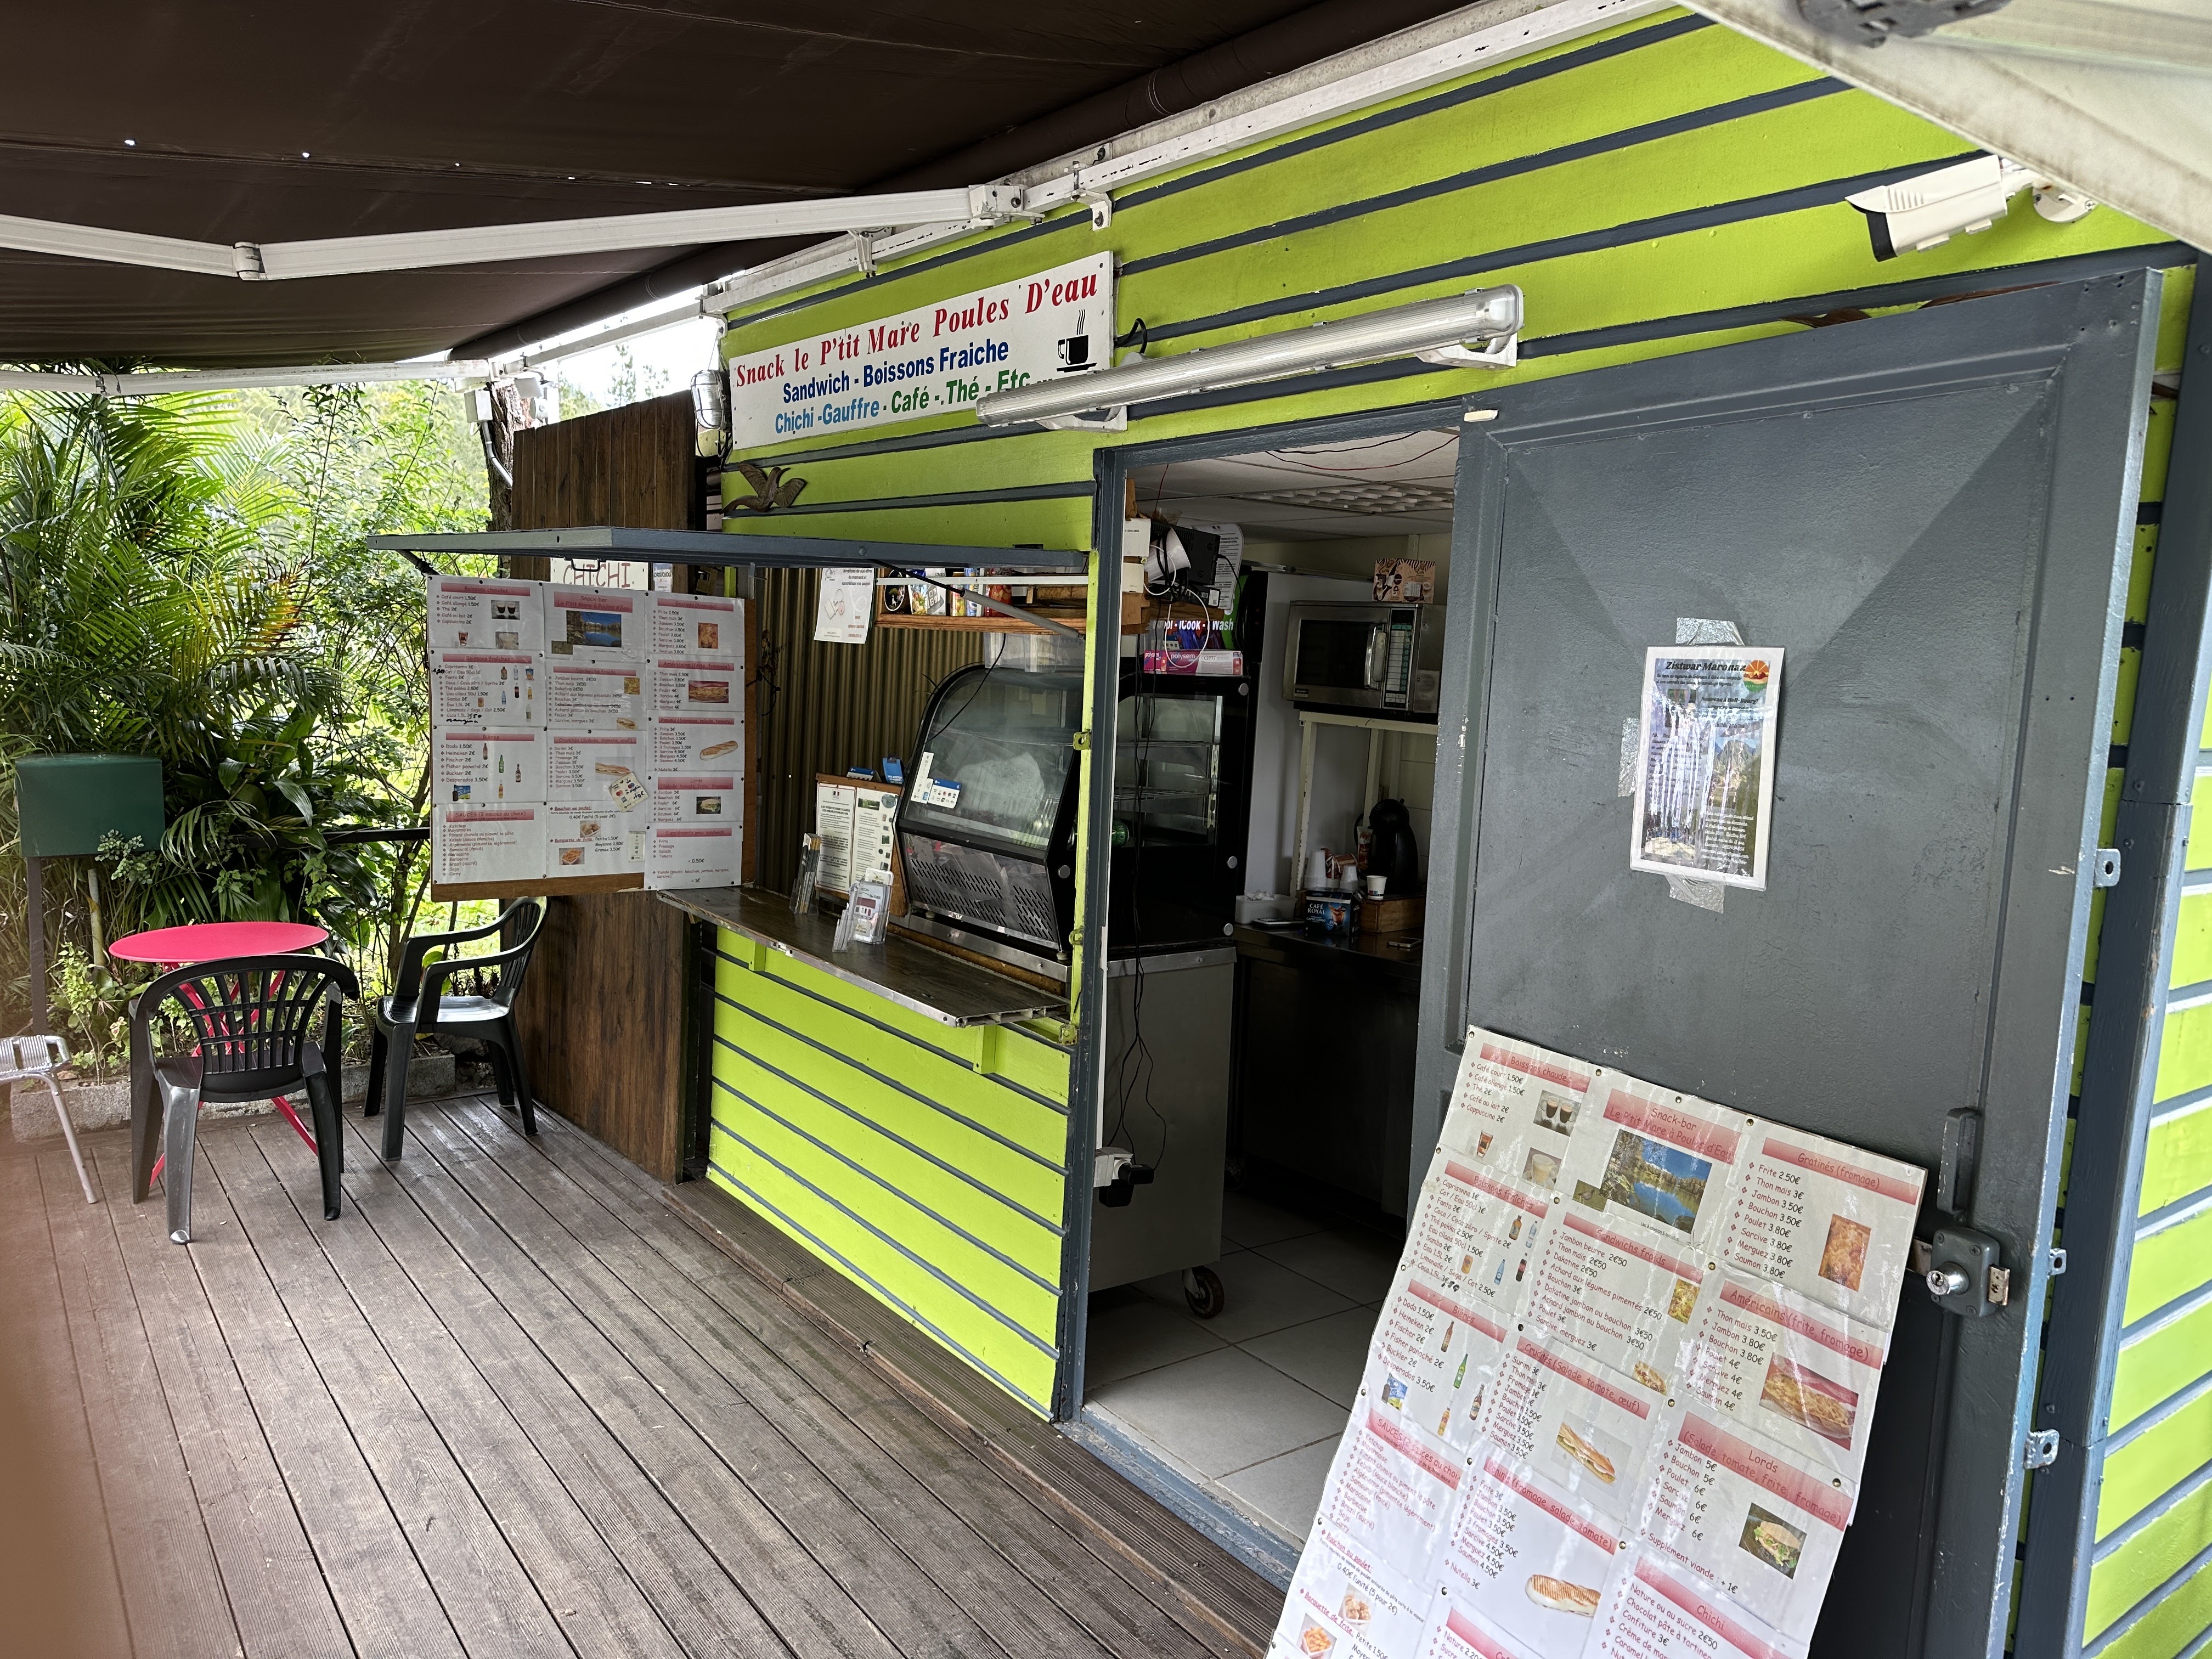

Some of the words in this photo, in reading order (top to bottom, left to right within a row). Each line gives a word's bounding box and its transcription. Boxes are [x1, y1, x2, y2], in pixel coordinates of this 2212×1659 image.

[737, 354, 785, 387] Snack
[795, 348, 809, 372] le
[820, 334, 859, 365] P'tit
[867, 323, 919, 354] Mare
[933, 297, 1009, 337] Poules
[1025, 274, 1097, 314] D'eau
[783, 370, 849, 403] Sandwich
[864, 357, 934, 387] Boissons
[939, 338, 1008, 372] Fraiche
[775, 407, 814, 433] Chichi
[891, 386, 929, 414] Café
[946, 376, 979, 404] Thé
[997, 368, 1030, 392] Etc
[563, 562, 630, 588] CHICHI
[1666, 661, 1702, 671] Zistwar
[1477, 1064, 1489, 1073] Café
[1507, 1074, 1523, 1084] 1.50€
[1510, 1056, 1541, 1074] Boissons
[1542, 1067, 1571, 1083] chaudes
[1472, 1084, 1483, 1092] Thé
[1466, 1104, 1496, 1120] Cappuccino
[1497, 1115, 1505, 1123] 2€
[1469, 1094, 1482, 1104] Café
[1491, 1102, 1500, 1110] lait
[1501, 1105, 1509, 1114] 2€
[1610, 1107, 1619, 1119] Le
[1669, 1127, 1673, 1138] à
[1651, 1108, 1697, 1131] Snack-bar
[1758, 1164, 1777, 1178] Frite
[1779, 1171, 1801, 1185] 2.50€
[1798, 1153, 1834, 1173] Gratinés
[1836, 1165, 1880, 1190] (fromage)
[1443, 1180, 1471, 1198] Caprisonne
[1472, 1192, 1479, 1200] 1€
[1752, 1189, 1780, 1207] Jambon
[1781, 1200, 1804, 1214] 3.50€
[1436, 1198, 1452, 1208] Fanta
[1453, 1205, 1461, 1214] 2€
[1748, 1202, 1778, 1220] Bouchon
[1779, 1214, 1802, 1228] 3.50€
[1431, 1215, 1440, 1224] Thé
[1441, 1221, 1456, 1233] pokka
[1457, 1230, 1474, 1241] 2.50€
[1434, 1207, 1446, 1216] Coca
[1451, 1215, 1464, 1226] Coca
[1465, 1222, 1477, 1233] zéro
[1483, 1231, 1502, 1245] Sprite
[1503, 1240, 1511, 1249] 2€
[1743, 1214, 1767, 1230] Poulet
[1768, 1223, 1791, 1238] 3.80€
[1560, 1232, 1583, 1246] Jambon
[1584, 1243, 1605, 1257] beurre
[1609, 1254, 1627, 1266] 2€50
[1741, 1228, 1768, 1244] Sarcive
[1770, 1238, 1793, 1252] 3.80€
[1554, 1252, 1579, 1270] Dakatine
[1581, 1265, 1598, 1278] 2€50
[1640, 1248, 1667, 1266] froids
[1547, 1274, 1571, 1290] Bouchon
[1572, 1284, 1582, 1294] 3€
[1550, 1263, 1572, 1278] Achard
[1573, 1274, 1584, 1284] aux
[1586, 1278, 1615, 1299] légumes
[1612, 1292, 1643, 1312] pimentés
[1644, 1306, 1662, 1320] 2€50
[1398, 1310, 1424, 1330] Heineken
[1425, 1325, 1434, 1335] 2€
[1402, 1298, 1417, 1312] Dodo
[1418, 1306, 1435, 1321] 1.50€
[1453, 1305, 1475, 1324] Bières
[1394, 1321, 1415, 1339] Fischer
[1416, 1334, 1425, 1344] 2€
[1712, 1322, 1740, 1341] Jambon
[1742, 1335, 1765, 1351] 3.80€
[1730, 1289, 1786, 1322] Américains
[1820, 1330, 1869, 1361] fromage)
[1386, 1344, 1407, 1362] Buckler
[1408, 1357, 1418, 1368] 2€
[1390, 1332, 1408, 1348] Fisher
[1409, 1344, 1433, 1363] panaché
[1434, 1358, 1444, 1369] 2€
[1708, 1334, 1739, 1355] Bouchon
[1740, 1349, 1764, 1365] 3.80€
[1383, 1356, 1415, 1381] Desperados
[1415, 1376, 1436, 1392] 3.50€
[1525, 1344, 1552, 1366] Crudités
[1553, 1359, 1583, 1381] (Salade,
[1587, 1376, 1615, 1401] tomate,
[1377, 1418, 1403, 1441] SAUCES
[1364, 1434, 1384, 1452] Ketchup
[1356, 1458, 1373, 1473] Kebab
[1748, 1449, 1779, 1473] Lords
[1684, 1430, 1718, 1459] (Salade,
[1722, 1452, 1757, 1478] tomate,
[1761, 1473, 1788, 1498] frite,
[1796, 1491, 1842, 1527] fromage)
[1344, 1492, 1368, 1514] Barbecue
[1511, 1478, 1548, 1507] (fromage,
[1648, 1533, 1689, 1564] Supplément
[1690, 1558, 1714, 1581] viande
[1726, 1582, 1738, 1592] 1€
[1622, 1610, 1656, 1639] Confiture
[1657, 1634, 1669, 1646] 3€
[1630, 1582, 1655, 1606] Nature
[1656, 1601, 1666, 1613] ou
[1666, 1611, 1675, 1621] au
[1677, 1616, 1697, 1636] sucre
[1697, 1630, 1718, 1651] 2€50
[1696, 1604, 1726, 1631] Chichi
